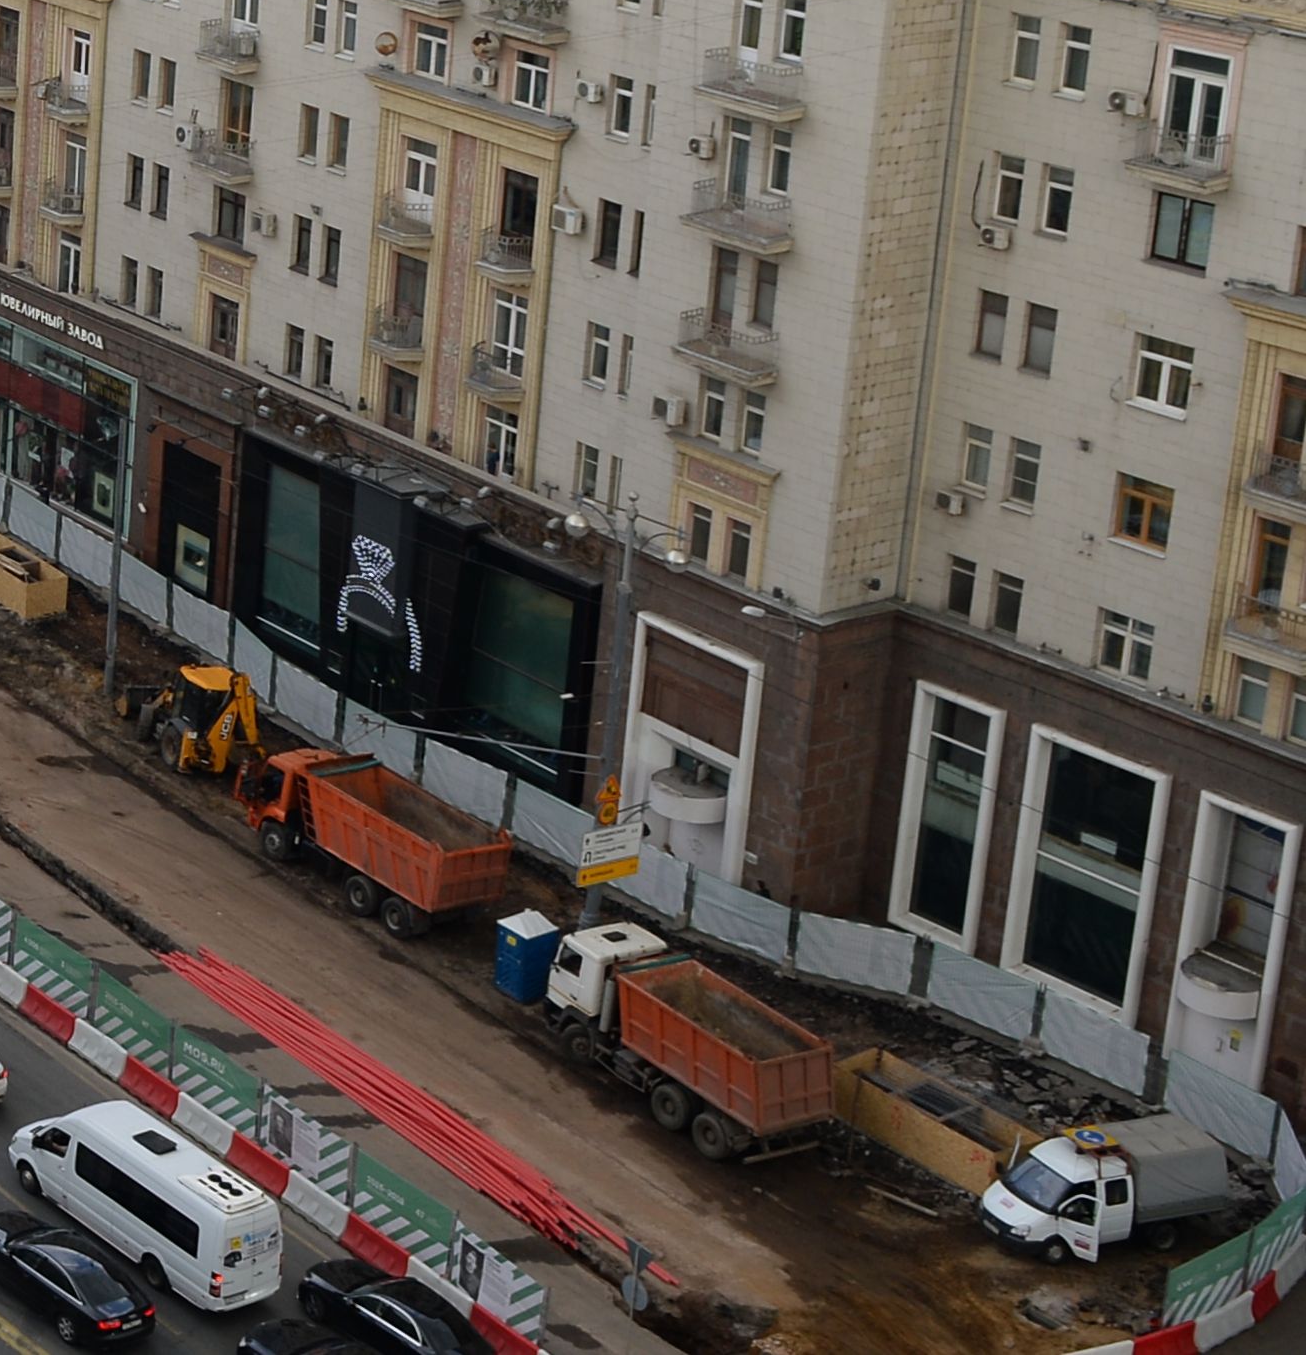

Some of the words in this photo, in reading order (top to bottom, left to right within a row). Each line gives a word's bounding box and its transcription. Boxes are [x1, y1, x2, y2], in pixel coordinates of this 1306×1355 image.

[0, 293, 64, 331] ЮВЕЛИРНЫЙ
[67, 322, 104, 350] ЗАВОД
[219, 714, 233, 741] JCB
[183, 1041, 226, 1074] MOS.RU
